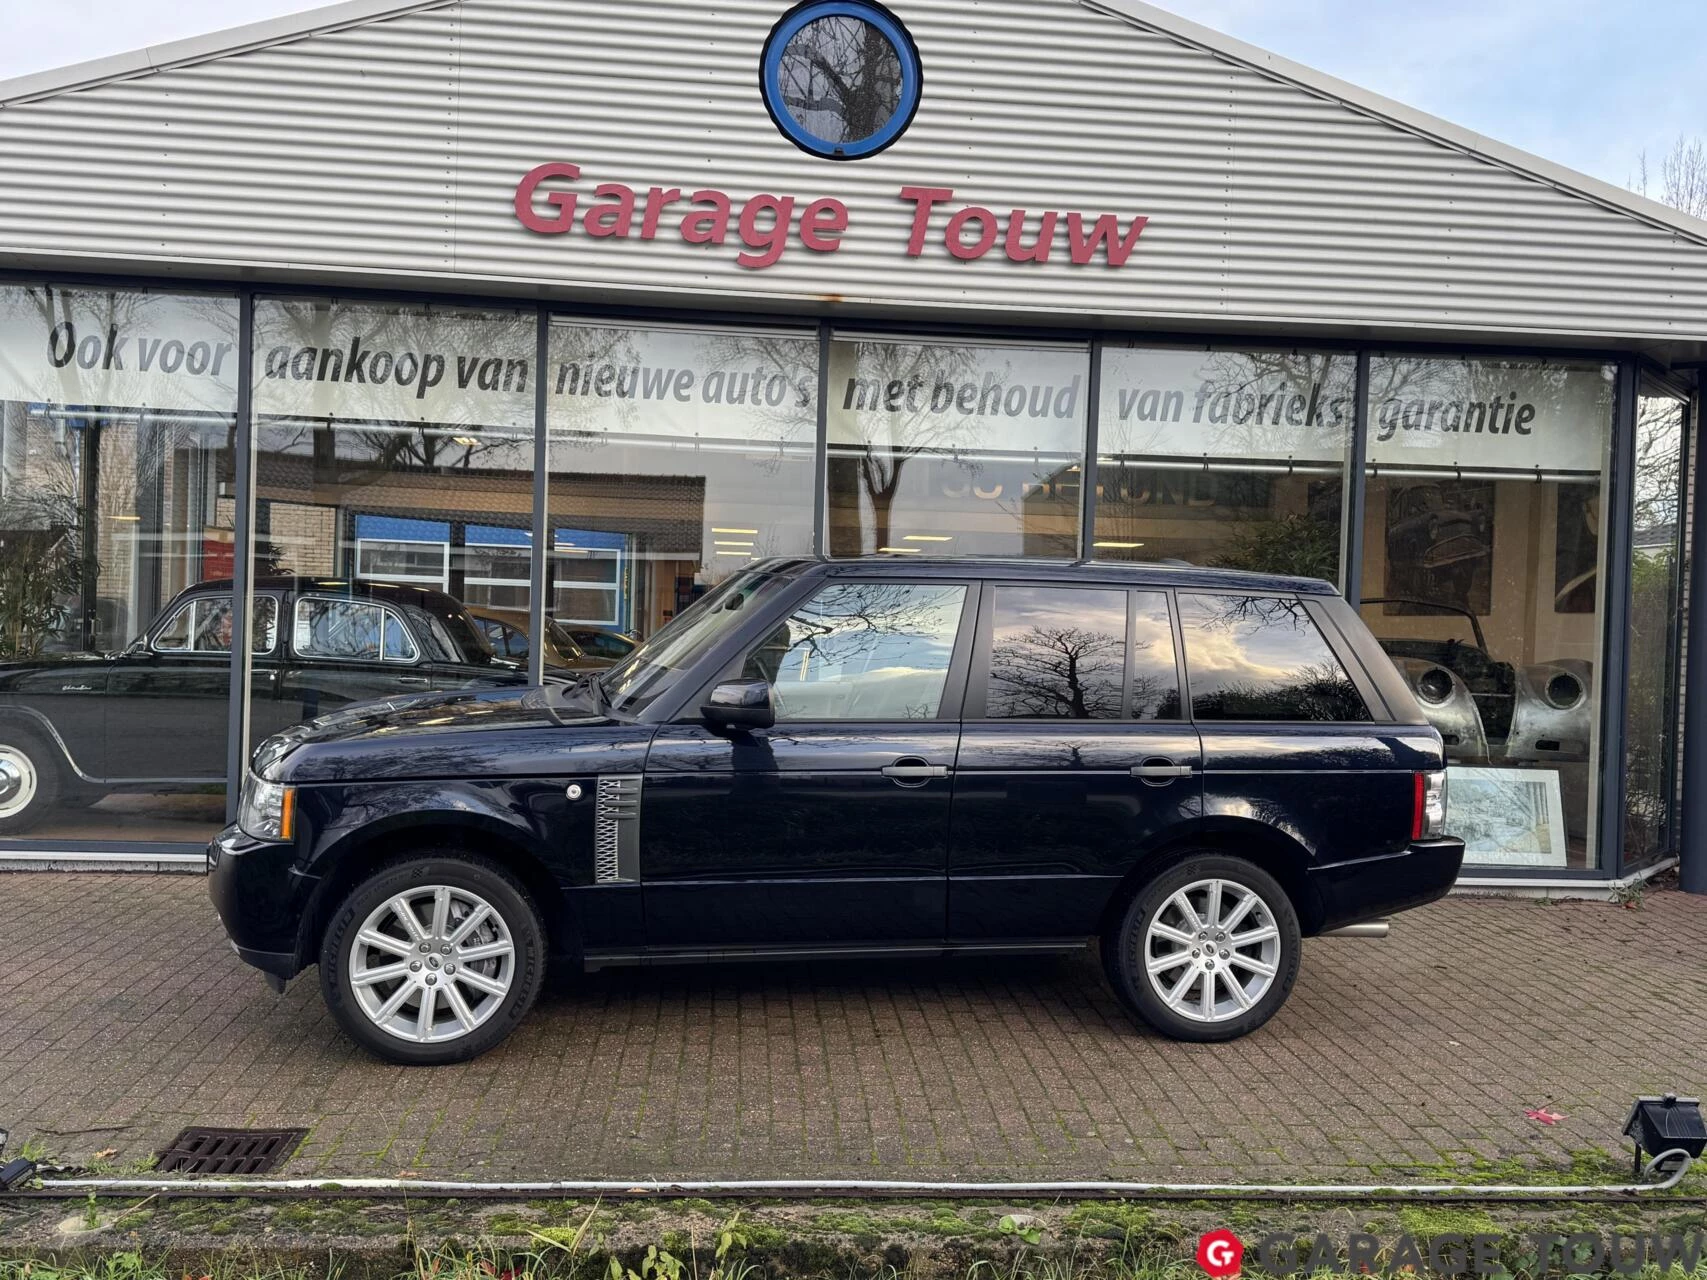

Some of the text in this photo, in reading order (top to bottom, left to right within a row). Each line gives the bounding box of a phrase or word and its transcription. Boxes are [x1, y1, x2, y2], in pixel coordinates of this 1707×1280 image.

[514, 162, 1148, 268] Garage Touw
[47, 321, 126, 371] Ook
[138, 336, 233, 377] voor
[265, 336, 446, 399] aankoop
[456, 354, 531, 392] van
[555, 352, 693, 403] nieuwe
[702, 362, 813, 408] auto's
[843, 374, 924, 412] met
[931, 369, 1082, 418] behoud
[1118, 387, 1186, 423] van
[1377, 392, 1537, 442] garantie
